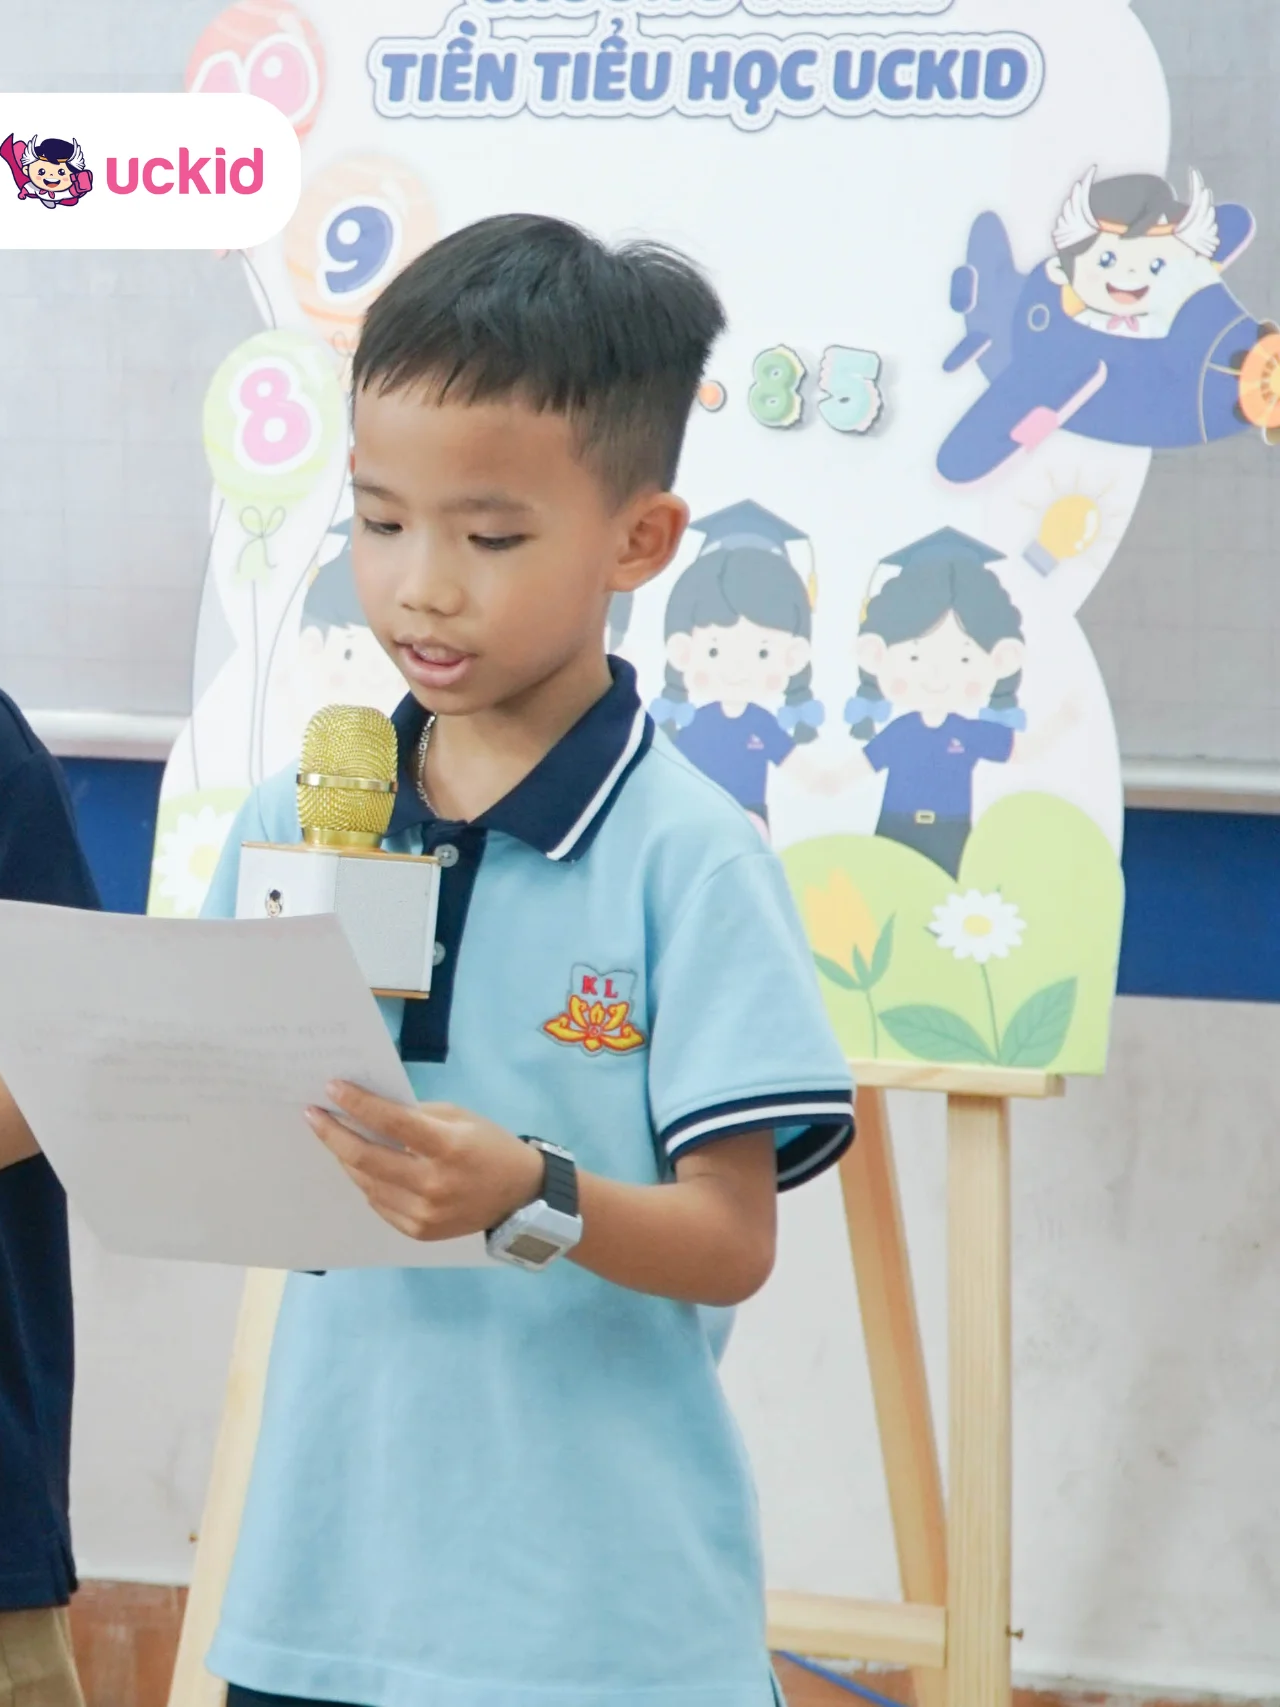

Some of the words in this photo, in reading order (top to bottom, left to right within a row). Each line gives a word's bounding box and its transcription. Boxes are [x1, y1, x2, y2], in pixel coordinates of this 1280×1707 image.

[382, 20, 517, 102] TIỀN
[534, 17, 672, 102] TIỂU
[687, 50, 819, 115] HỌC
[833, 48, 1029, 101] UCKID
[324, 206, 395, 294] 9
[239, 367, 312, 466] 8
